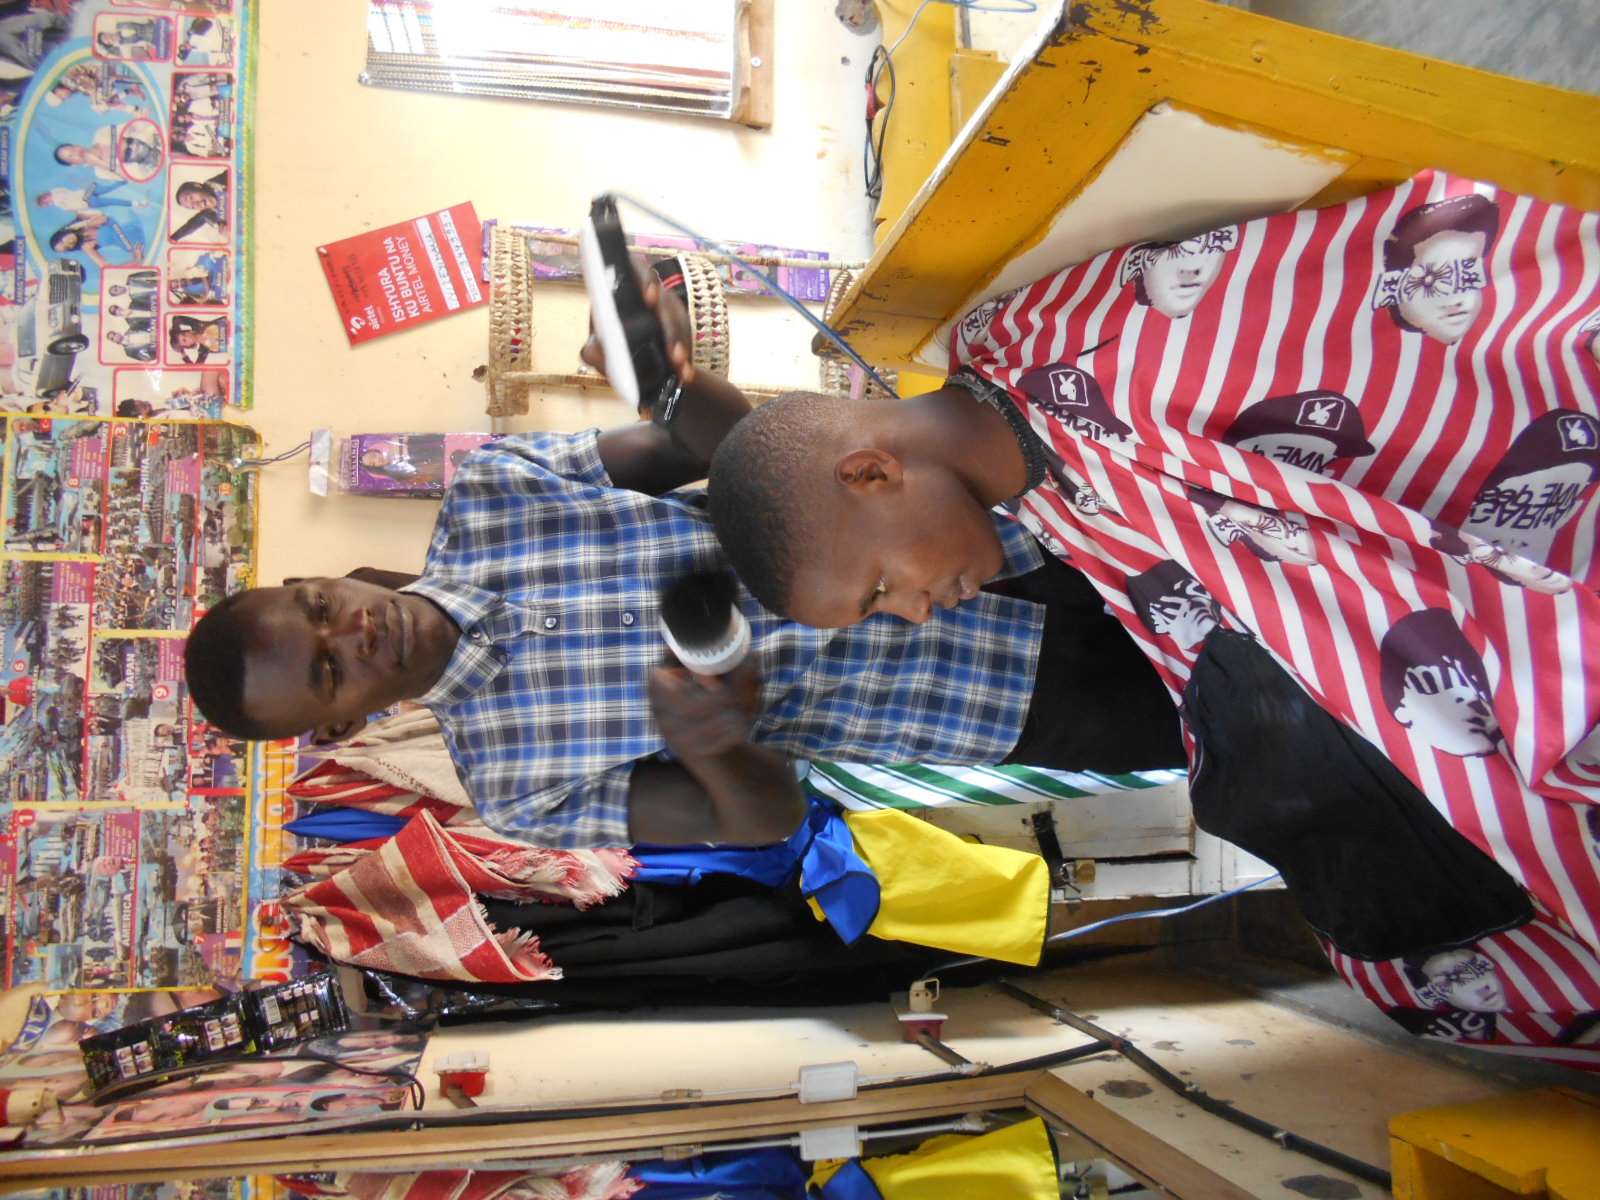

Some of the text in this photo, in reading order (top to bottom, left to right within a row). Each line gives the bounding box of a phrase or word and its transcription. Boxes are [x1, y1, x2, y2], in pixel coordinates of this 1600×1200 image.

[378, 268, 406, 322] ISHYURA
[383, 236, 420, 318] KU BUNTU NA
[396, 236, 432, 312] AIRTEL MONEY
[364, 304, 380, 330] airtel
[140, 458, 150, 492] CHINA
[126, 653, 136, 688] JAPAN
[121, 893, 133, 946] AMERICA
